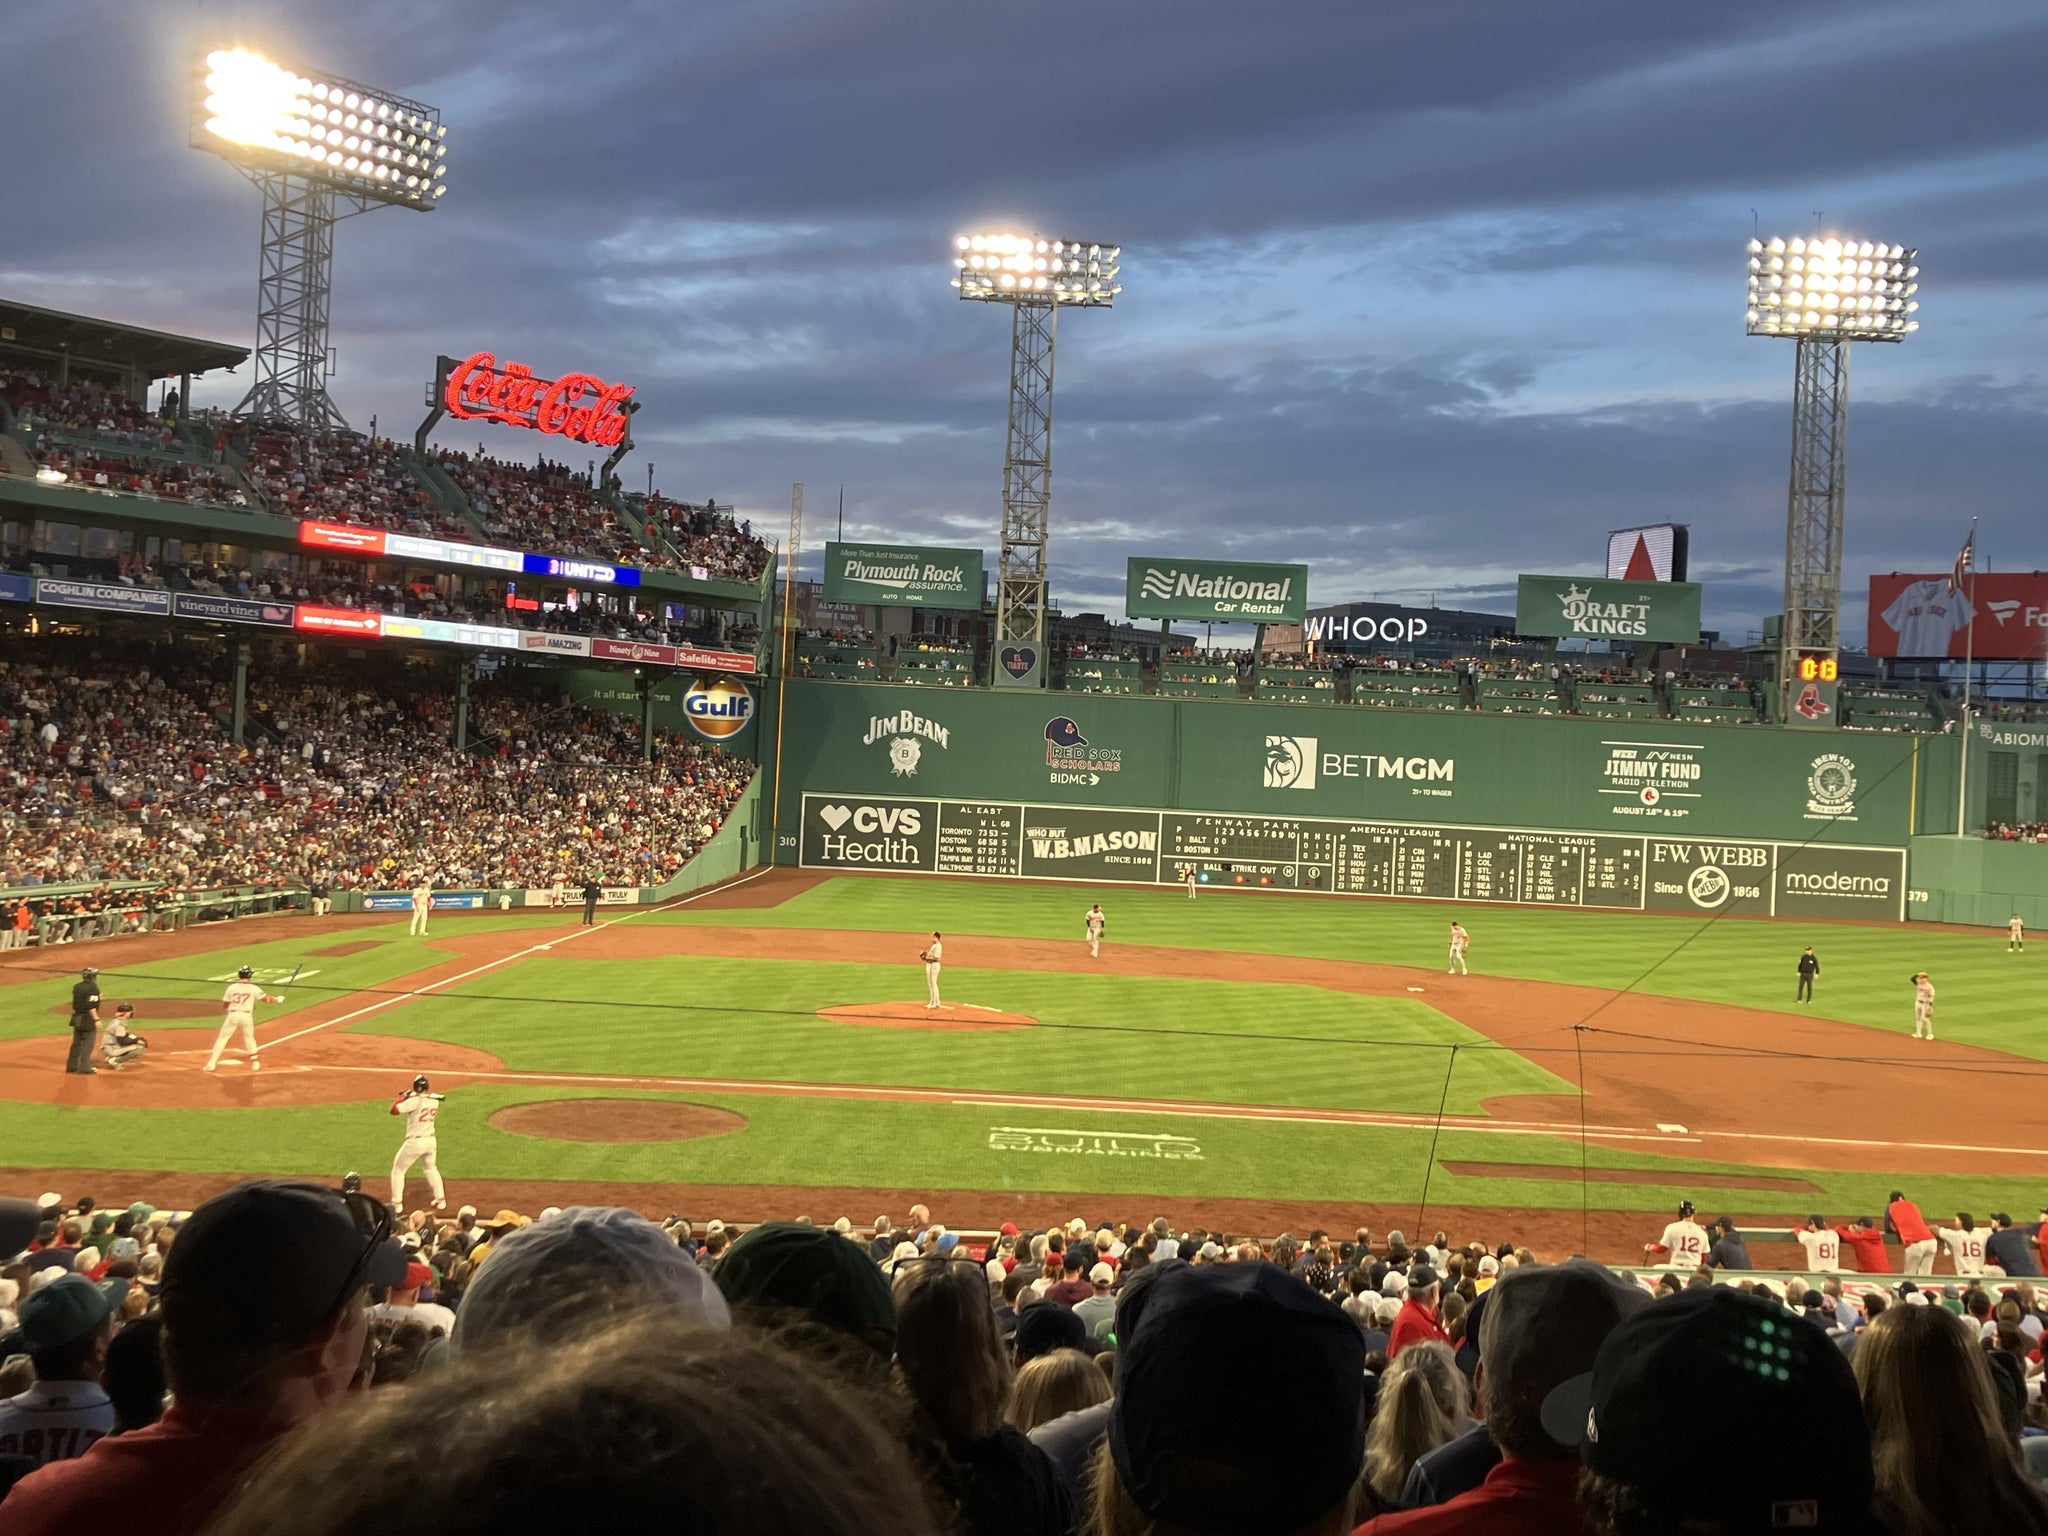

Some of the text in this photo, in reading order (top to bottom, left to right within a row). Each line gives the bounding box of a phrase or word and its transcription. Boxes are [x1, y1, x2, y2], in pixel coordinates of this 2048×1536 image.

[505, 362, 531, 378] ENJOY
[446, 352, 635, 446] Coca-Cola
[840, 549, 857, 558] More
[859, 550, 874, 559] Than
[875, 551, 888, 560] Just
[564, 561, 615, 580] UNITED
[845, 560, 963, 584] Plymouth Rock
[1176, 573, 1290, 601] National
[41, 582, 95, 598] COGHLIN
[97, 588, 168, 605] COMPANIES
[180, 599, 229, 616] vineyard
[230, 604, 260, 618] vines
[1215, 602, 1284, 615] Car Rental
[1562, 600, 1650, 620] DRAFT
[1304, 616, 1428, 642] WHOOP
[1573, 617, 1647, 635] KINGS
[547, 638, 582, 651] AMAZING
[609, 645, 660, 659] Ninety Nine
[680, 653, 717, 666] Safelite
[594, 689, 641, 702] It all start
[687, 694, 749, 718] Gulf
[863, 710, 949, 751] JIM BEAM
[1993, 732, 2048, 747] ABIOM
[1053, 747, 1121, 761] RED SOX
[1670, 753, 1693, 761] NESN
[1052, 759, 1121, 771] SCHOLARS
[1322, 753, 1454, 781] BETMGM
[1811, 754, 1855, 770] IBEW 103
[1604, 760, 1701, 779] JIMMY FUND
[1050, 772, 1087, 785] BIDMC
[1423, 788, 1430, 796] TO
[1431, 788, 1452, 797] WAGER
[977, 807, 1002, 815] EAST
[1612, 806, 1645, 815] AUGUST
[853, 806, 921, 835] CVS
[1001, 820, 1010, 828] GB
[1196, 817, 1299, 830] FENWAY PARK
[941, 827, 998, 837] TORONTO 73 53
[1026, 828, 1065, 838] WHO BUT
[1350, 826, 1440, 837] AMERICAN LEAGUE
[779, 836, 796, 847] 310
[978, 838, 987, 846] 68
[989, 838, 998, 846] 58
[1189, 835, 1207, 844] BALT
[1508, 834, 1596, 846] NATIONAL LEAGUE
[822, 834, 920, 864] Health
[940, 845, 997, 855] NEW YORK 67 57
[1183, 845, 1211, 854] BOSTON
[1478, 851, 1493, 859] LAD
[940, 854, 973, 863] TAMPA BAY
[1104, 855, 1152, 865] SINCE 1898
[1353, 852, 1364, 860] KC
[1540, 855, 1555, 863] CLE
[1653, 844, 1768, 868] F.W. WEBB
[939, 863, 974, 872] BALTIMORE
[976, 865, 985, 873] 58
[1174, 861, 1277, 874] AT BALL STRIKE OUT
[1477, 859, 1492, 867] COL
[1350, 867, 1365, 875] DET
[1411, 870, 1424, 878] MIN
[1477, 867, 1491, 875] STL
[1540, 870, 1553, 878] MIL
[1410, 878, 1424, 886] NYY
[1477, 874, 1490, 882] MIA
[1538, 877, 1554, 885] CHC
[1787, 871, 1888, 892] moderna
[1350, 882, 1363, 890] PIT
[1537, 885, 1554, 893] NYM
[1601, 881, 1615, 889] ATL
[1654, 881, 1683, 894] Since
[563, 891, 583, 900] TRULY
[608, 891, 628, 899] TRULY
[1477, 889, 1489, 897] PHI
[1536, 893, 1555, 901] WASH
[1908, 890, 1928, 902] 379
[232, 992, 250, 1004] 37
[989, 1132, 1201, 1154] BUILD
[988, 1143, 1206, 1161] SUBMARINES
[1679, 1236, 1700, 1253] 12
[1961, 1241, 1982, 1258] 16
[1819, 1243, 1836, 1259] 81
